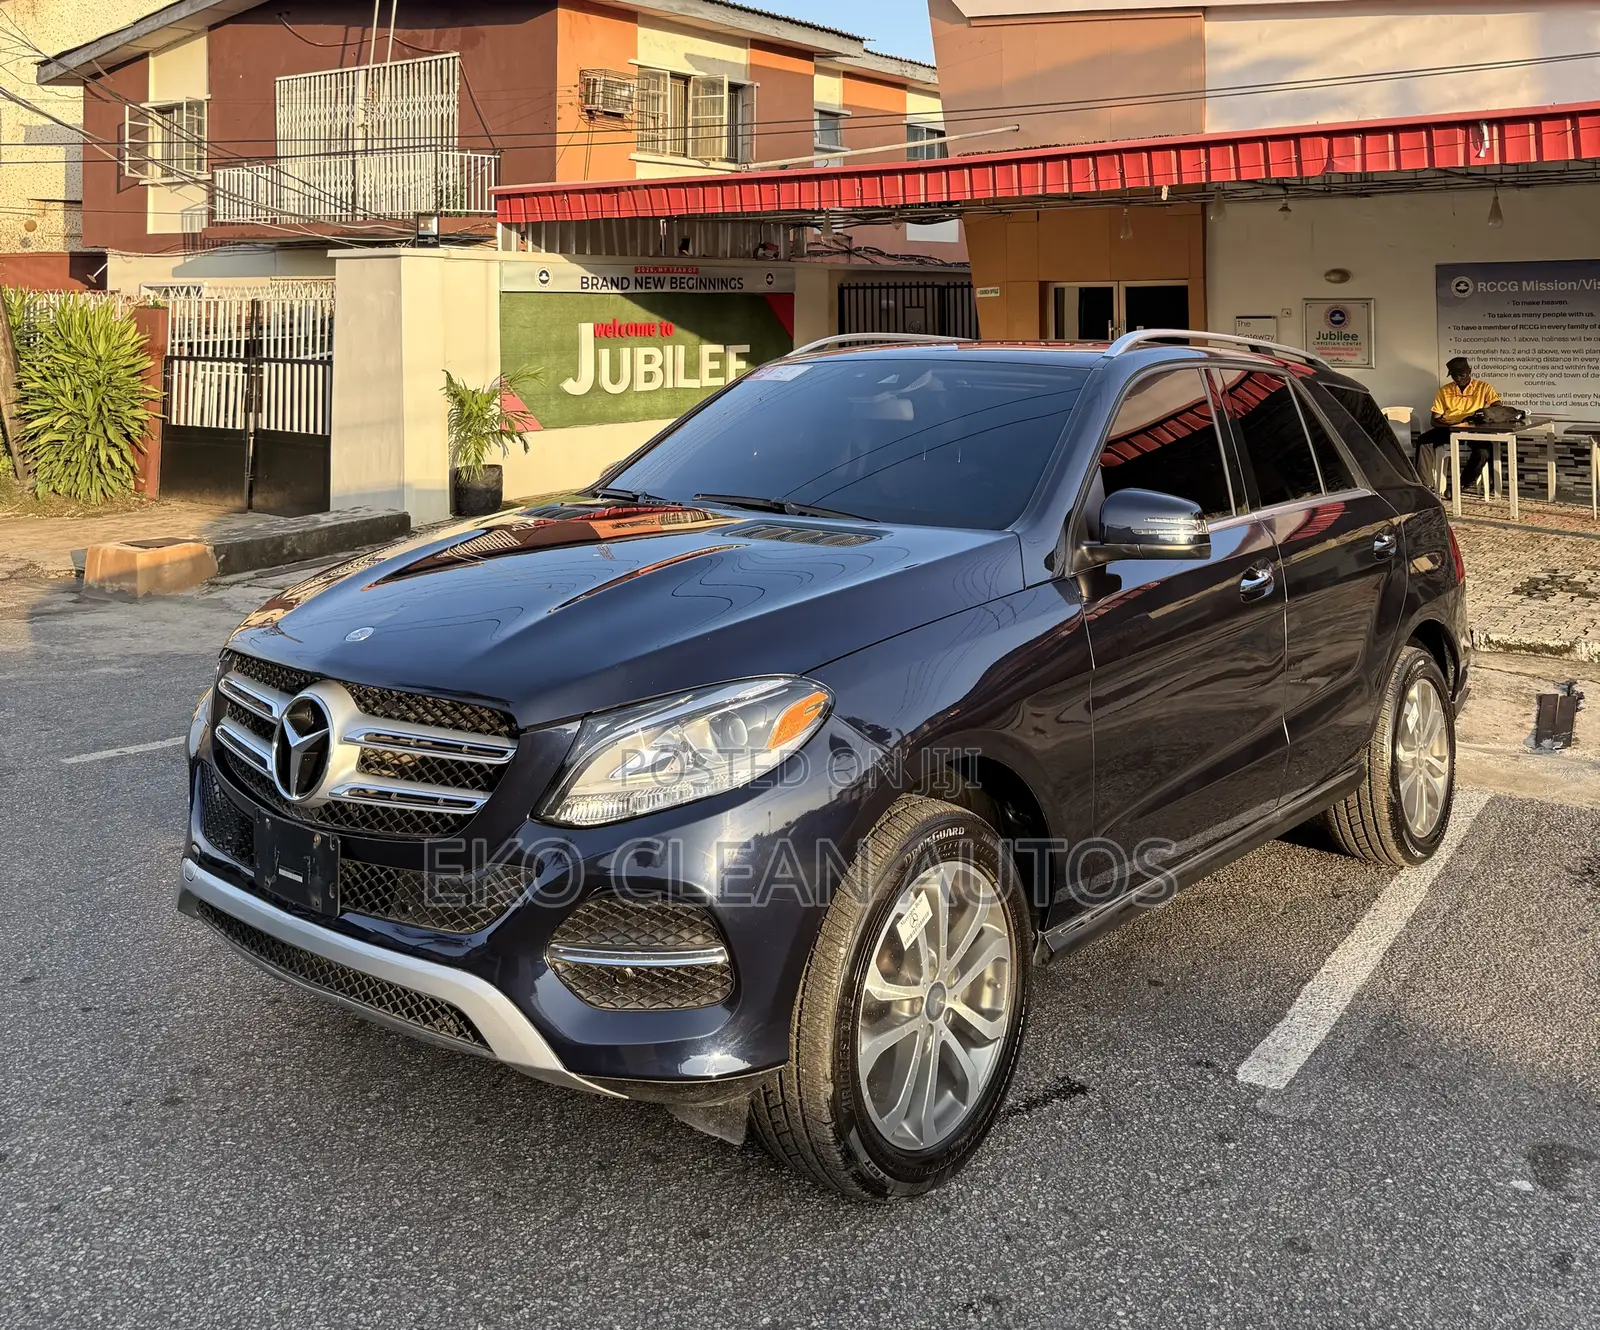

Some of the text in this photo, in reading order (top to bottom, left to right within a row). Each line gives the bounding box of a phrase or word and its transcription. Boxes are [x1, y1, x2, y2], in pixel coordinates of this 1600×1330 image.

[580, 276, 744, 291] BRAND NEW BEGINNINGS
[1477, 281, 1519, 293] RCCG
[594, 317, 675, 339] welcome to
[1237, 320, 1251, 328] The
[1316, 330, 1358, 341] Jubilee
[559, 322, 750, 396] JUBILEE
